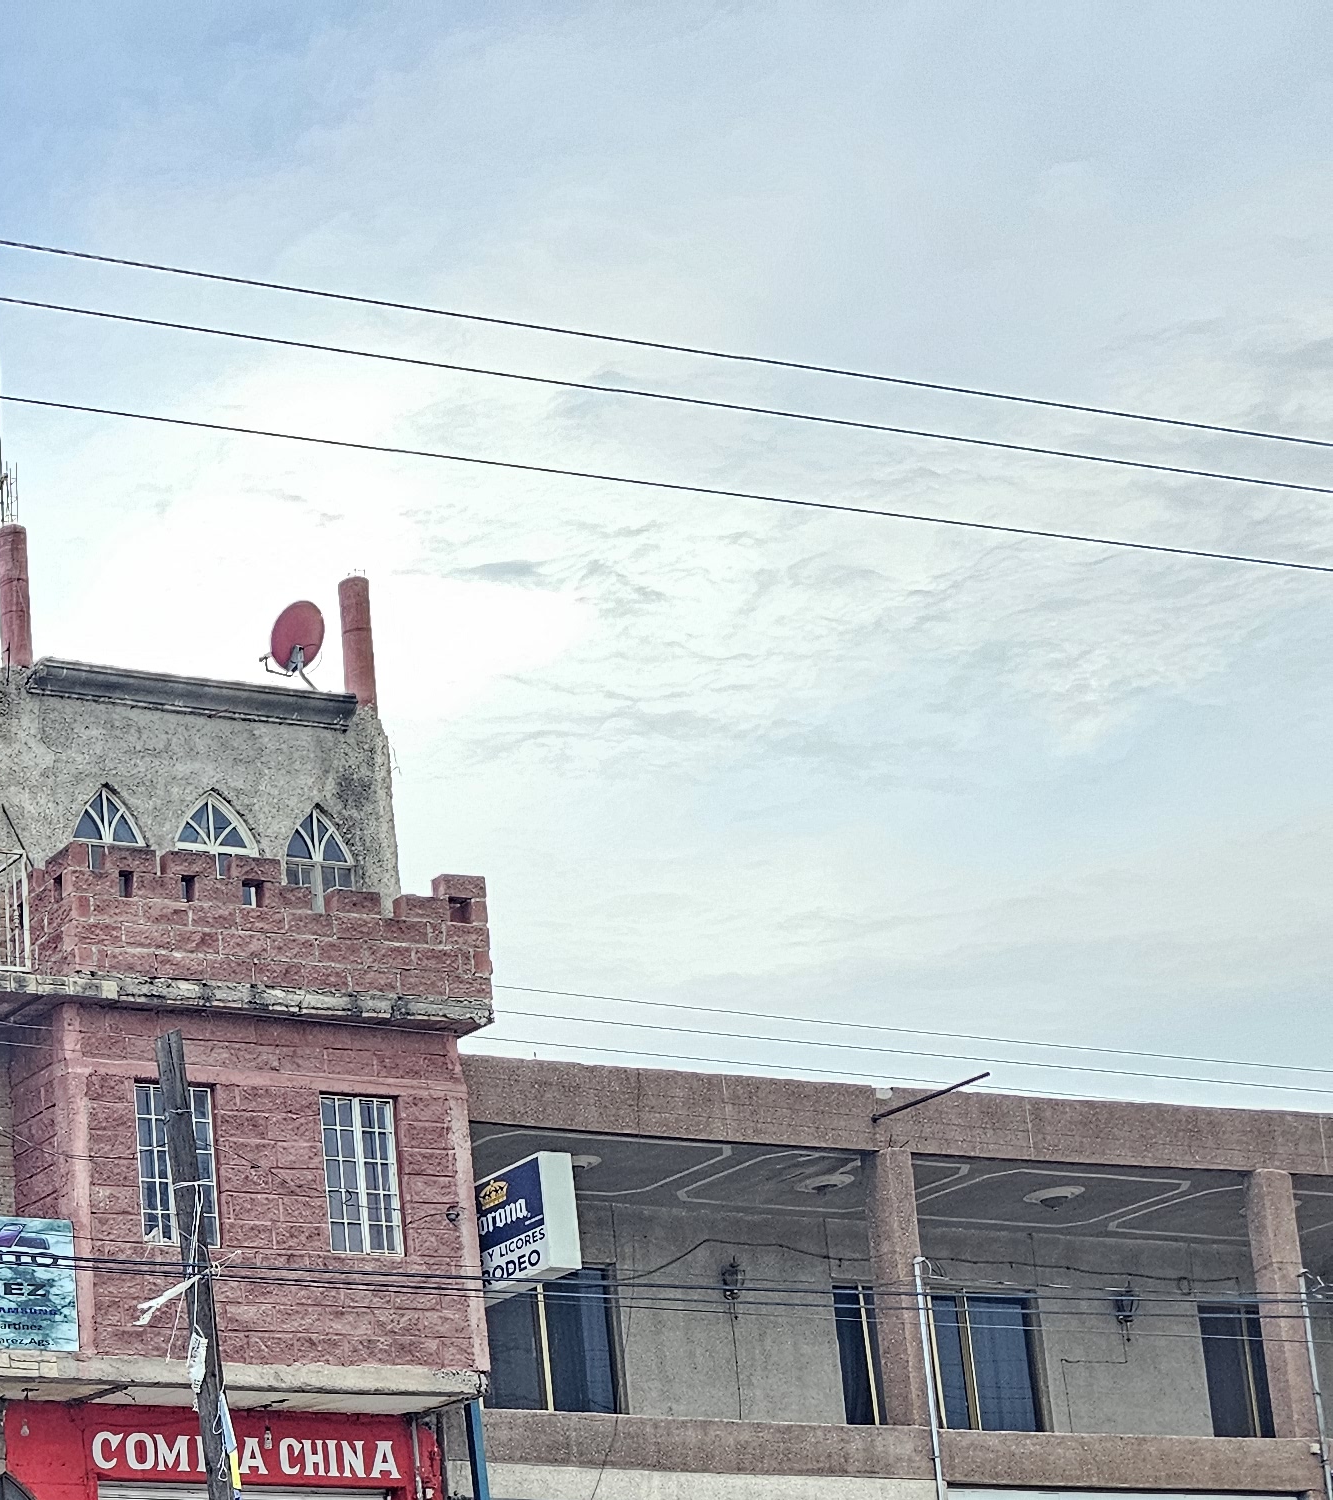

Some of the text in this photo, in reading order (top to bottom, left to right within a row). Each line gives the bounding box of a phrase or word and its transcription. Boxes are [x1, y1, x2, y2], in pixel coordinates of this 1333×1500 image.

[477, 1198, 532, 1236] orona
[498, 1227, 546, 1259] LICORES
[482, 1249, 541, 1289] RODEO
[91, 1430, 402, 1479] COMIA CHINA
